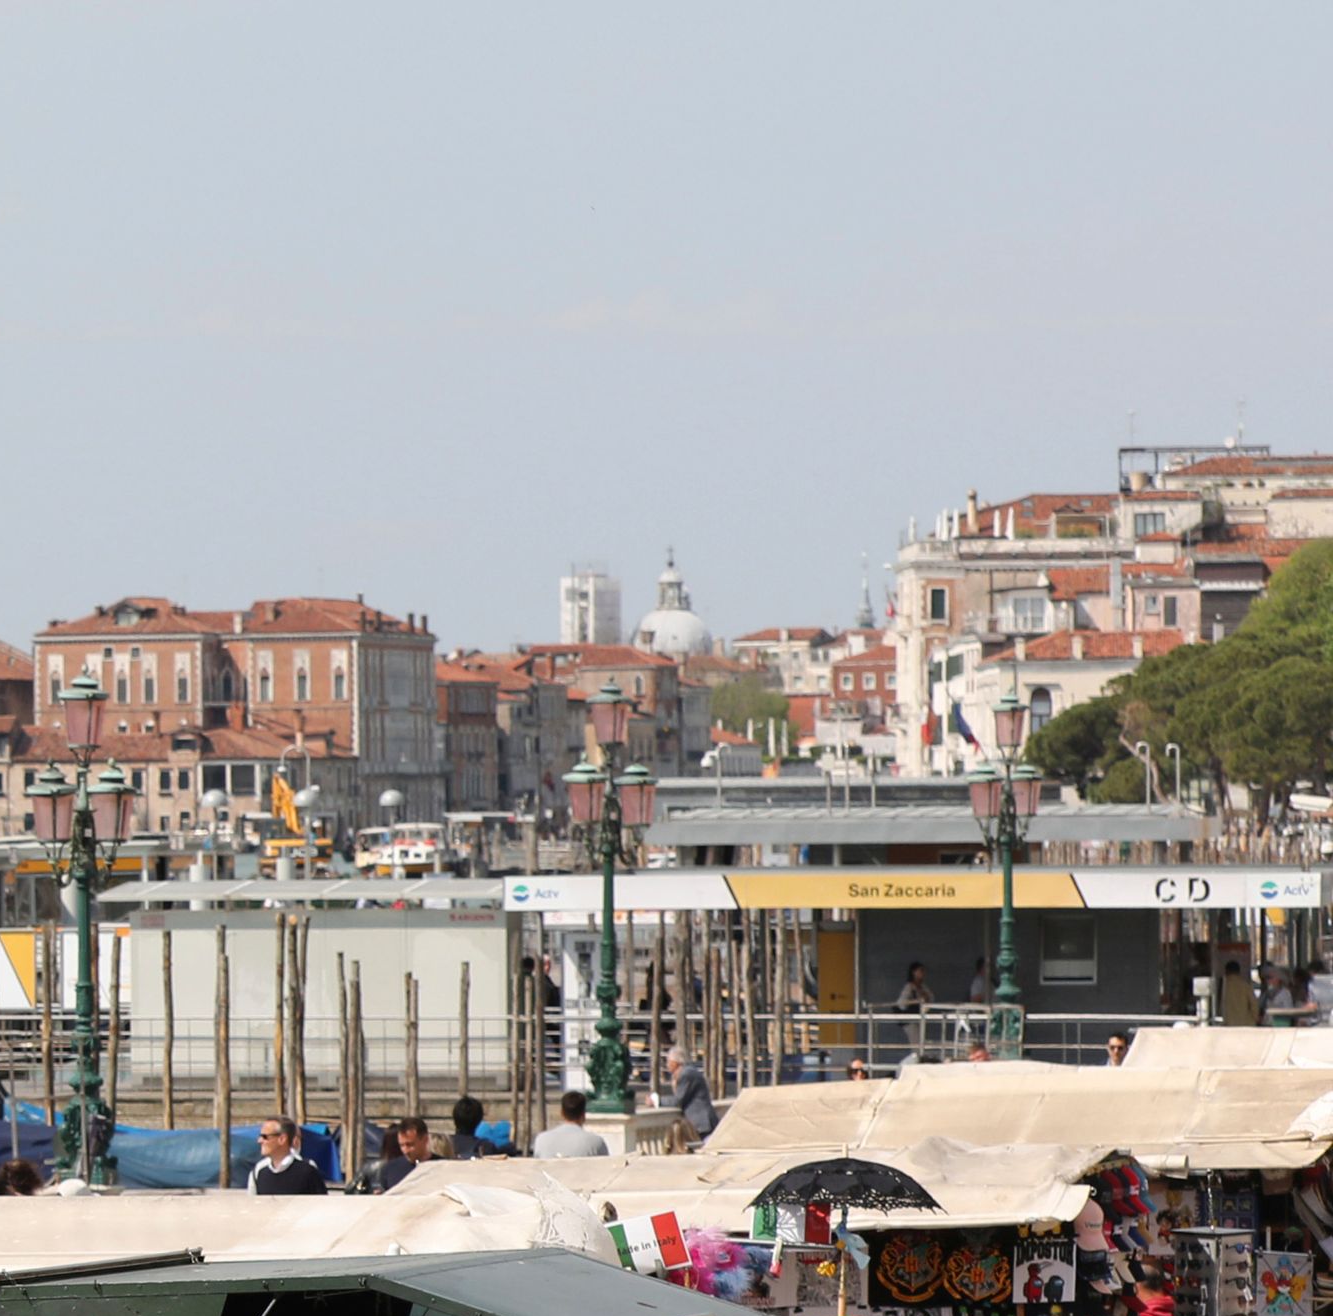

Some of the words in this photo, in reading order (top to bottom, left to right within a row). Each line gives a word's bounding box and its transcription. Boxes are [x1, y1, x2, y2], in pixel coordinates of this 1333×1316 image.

[534, 887, 559, 899] Actv
[848, 884, 880, 897] San
[883, 884, 956, 898] Zaccaria
[1155, 878, 1176, 903] C
